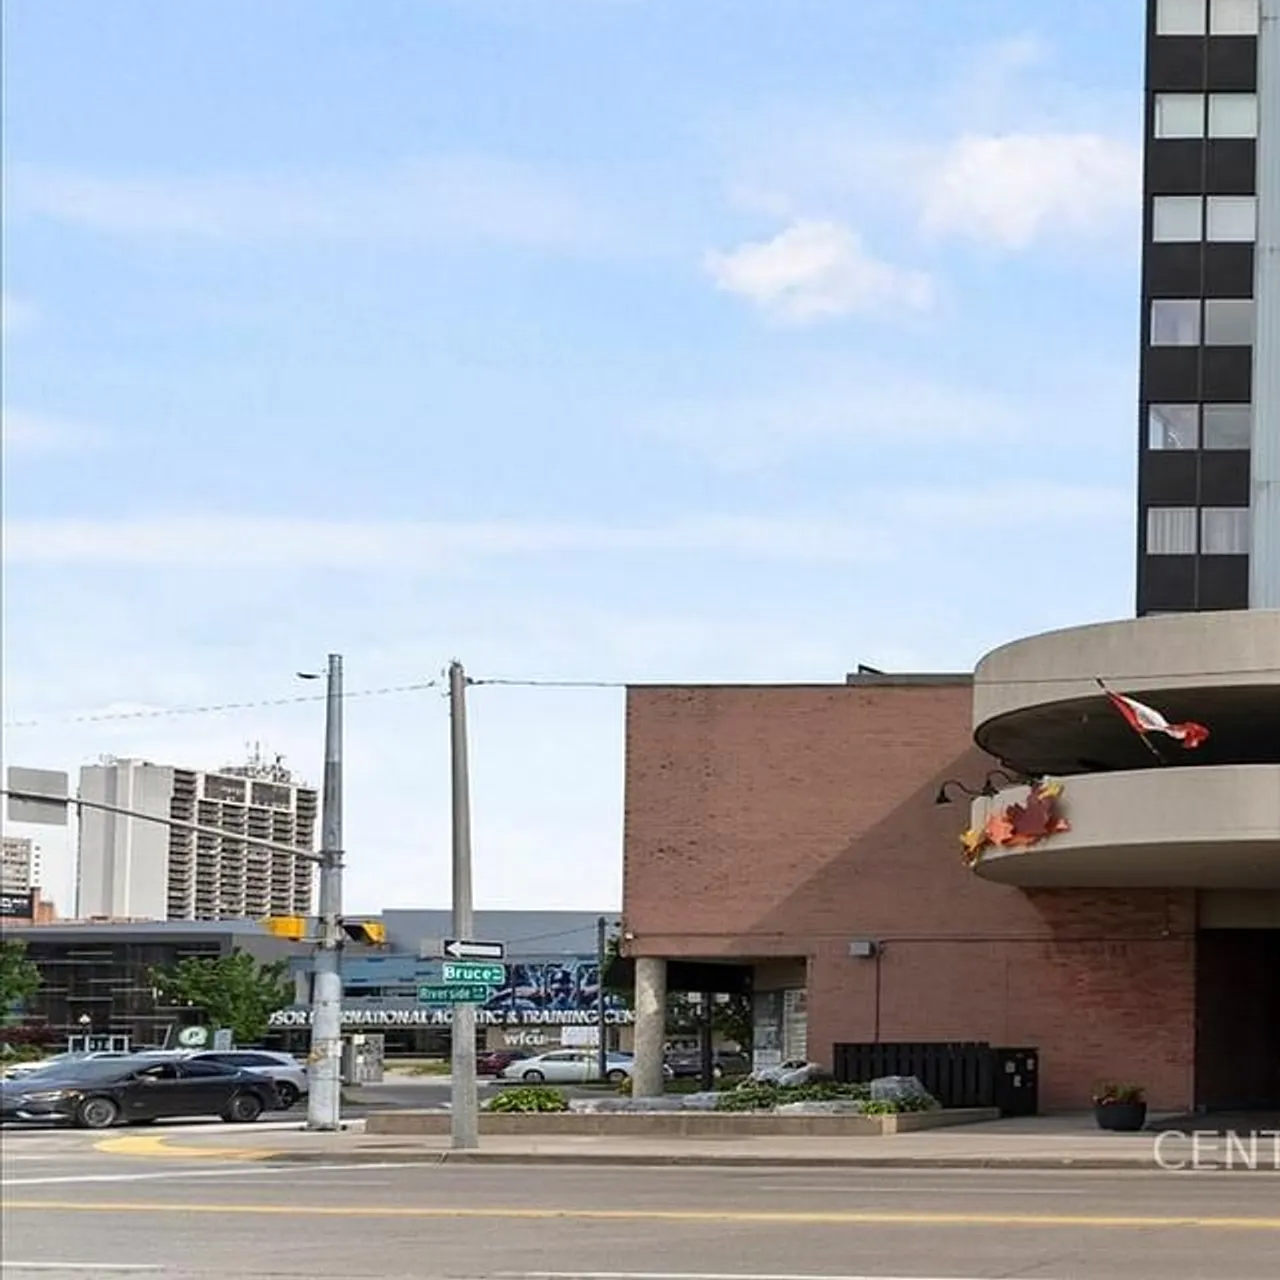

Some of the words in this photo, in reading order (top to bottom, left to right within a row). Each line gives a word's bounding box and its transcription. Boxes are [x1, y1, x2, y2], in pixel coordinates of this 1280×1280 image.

[444, 966, 491, 979] Bruce
[268, 1009, 307, 1024] SOR
[523, 1009, 600, 1023] TRAINING
[604, 1009, 640, 1023] CEN
[504, 1031, 545, 1046] wfcu
